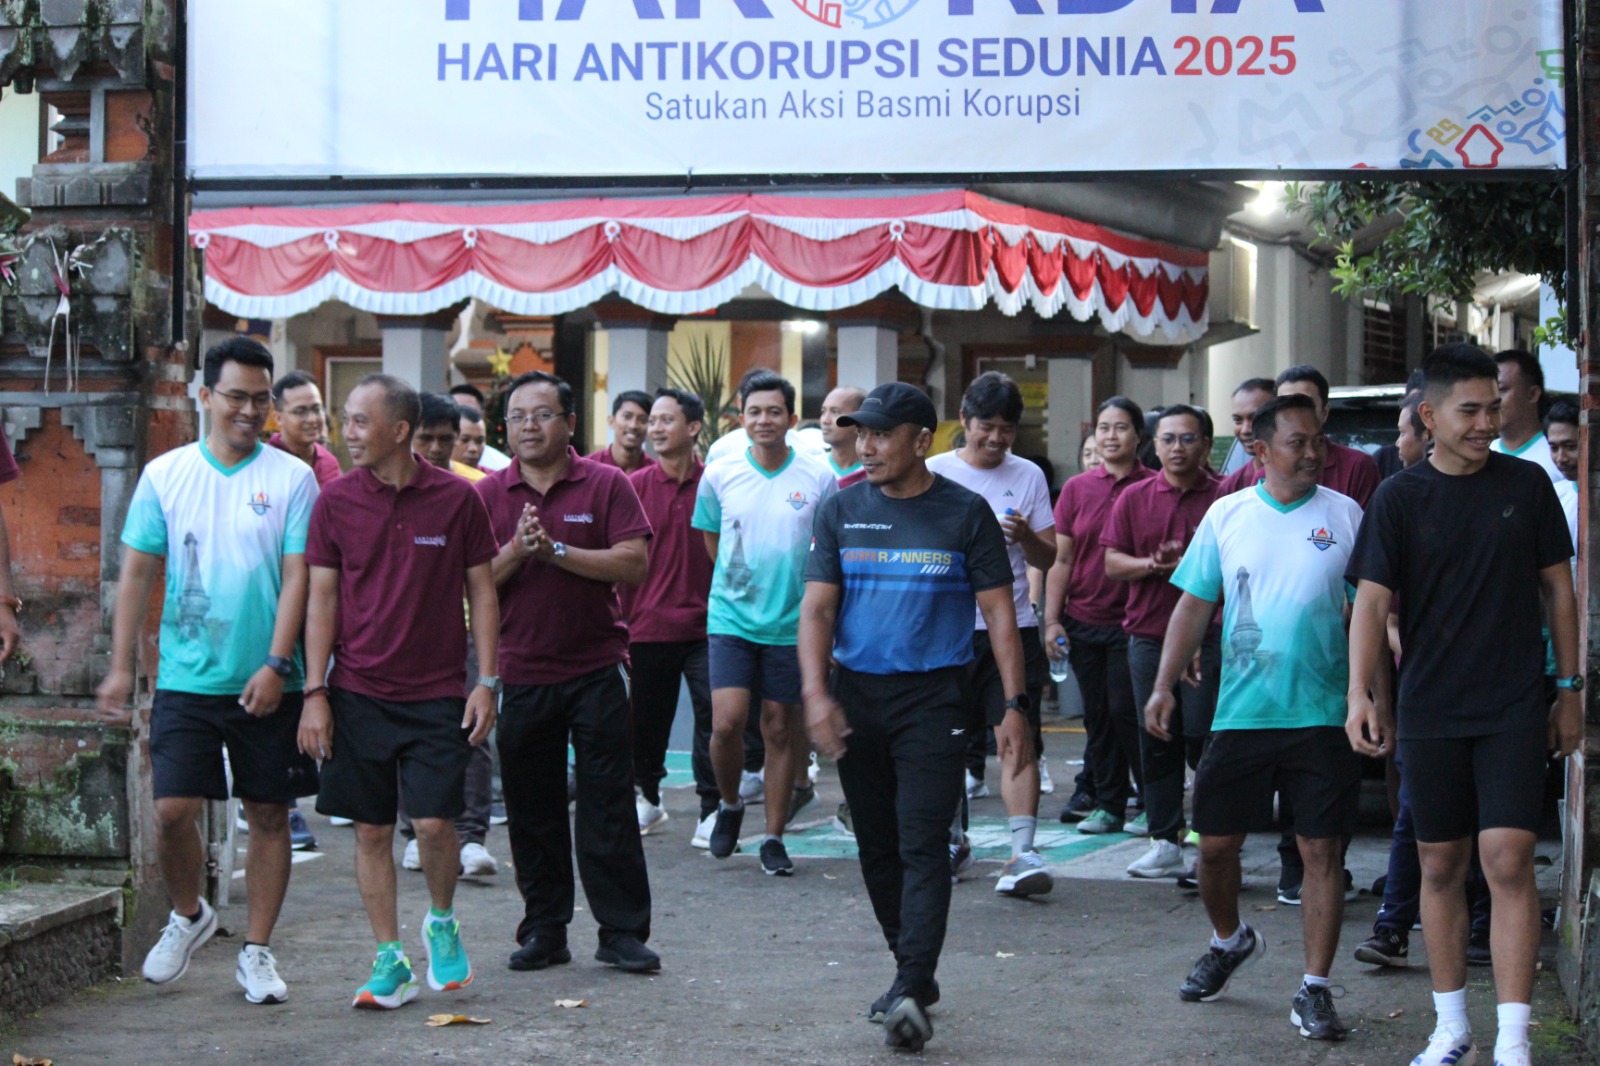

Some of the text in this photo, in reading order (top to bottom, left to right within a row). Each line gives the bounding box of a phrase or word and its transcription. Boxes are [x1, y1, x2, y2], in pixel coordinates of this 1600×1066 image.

[437, 35, 1297, 82] HARI ANTIKORUPSI SEDUNIA 2025
[645, 87, 1080, 124] Satukan Aksi Basmi Korupsi
